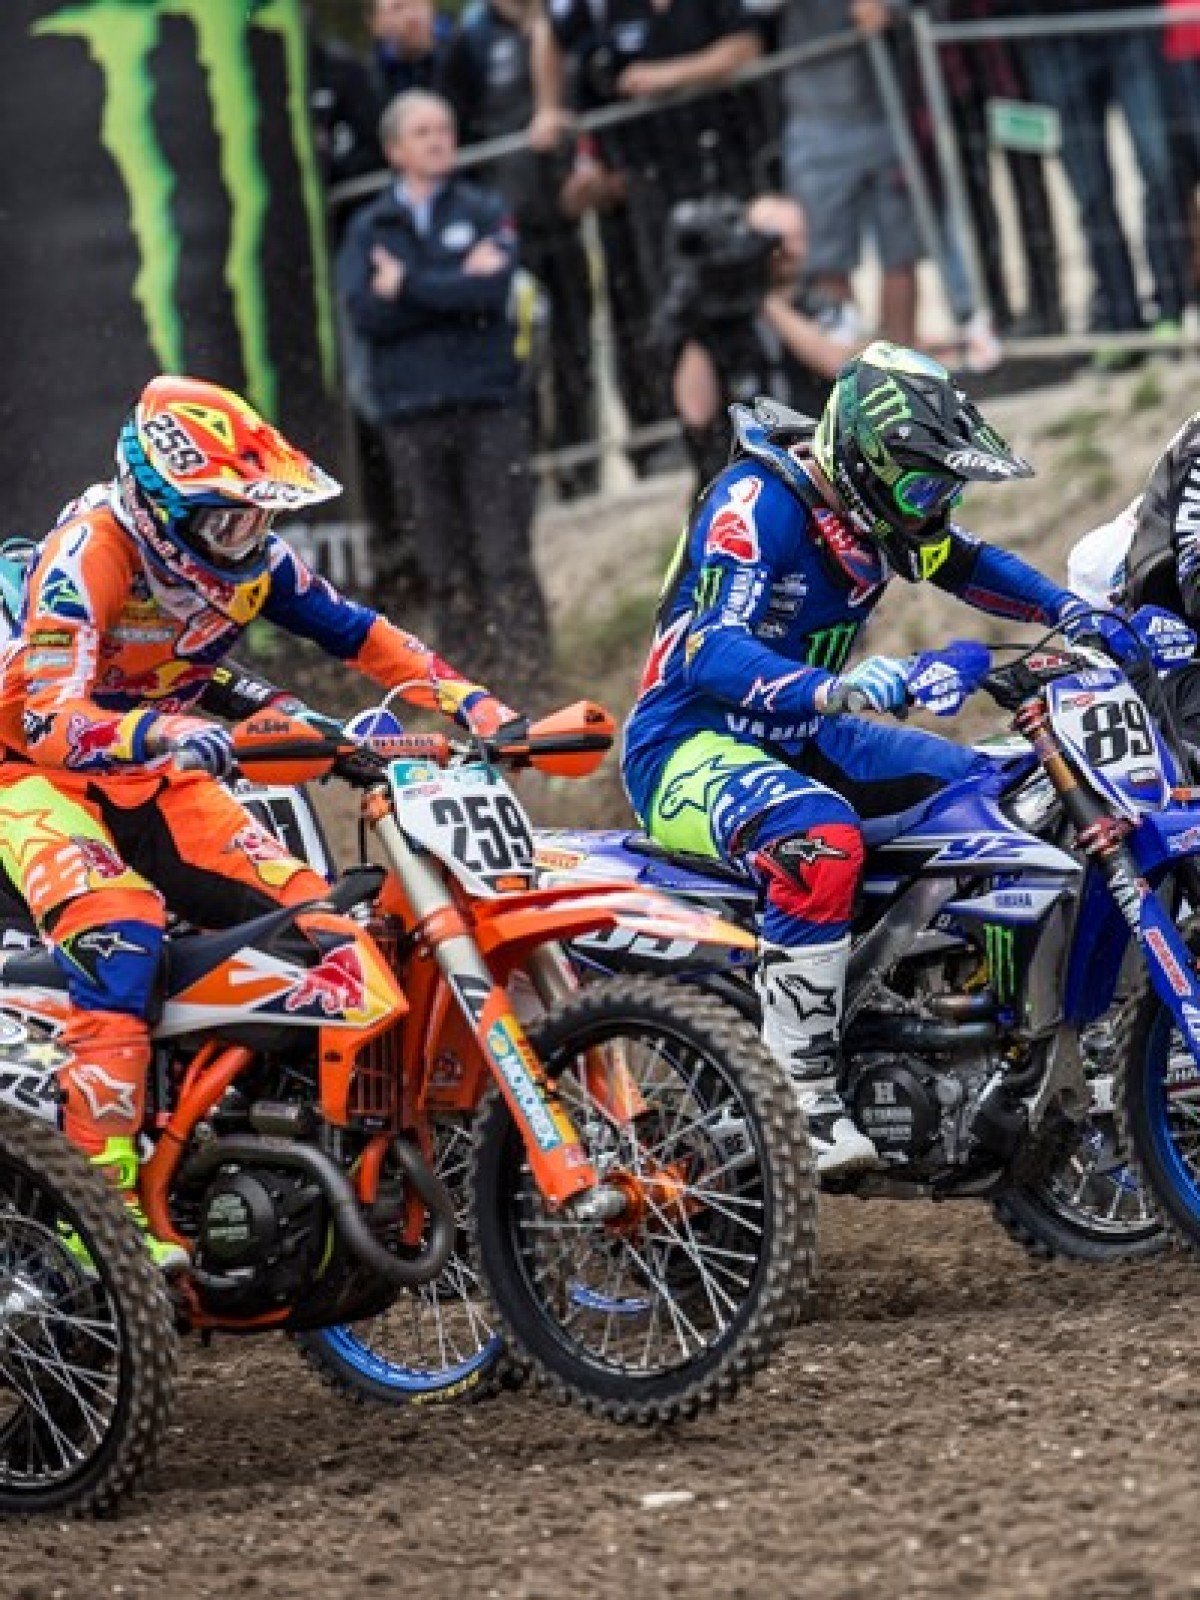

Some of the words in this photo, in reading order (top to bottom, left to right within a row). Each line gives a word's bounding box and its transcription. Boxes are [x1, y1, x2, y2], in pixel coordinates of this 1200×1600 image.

[1080, 699, 1157, 768] 89
[428, 795, 534, 873] 259
[500, 1055, 562, 1147] MOTOREX
